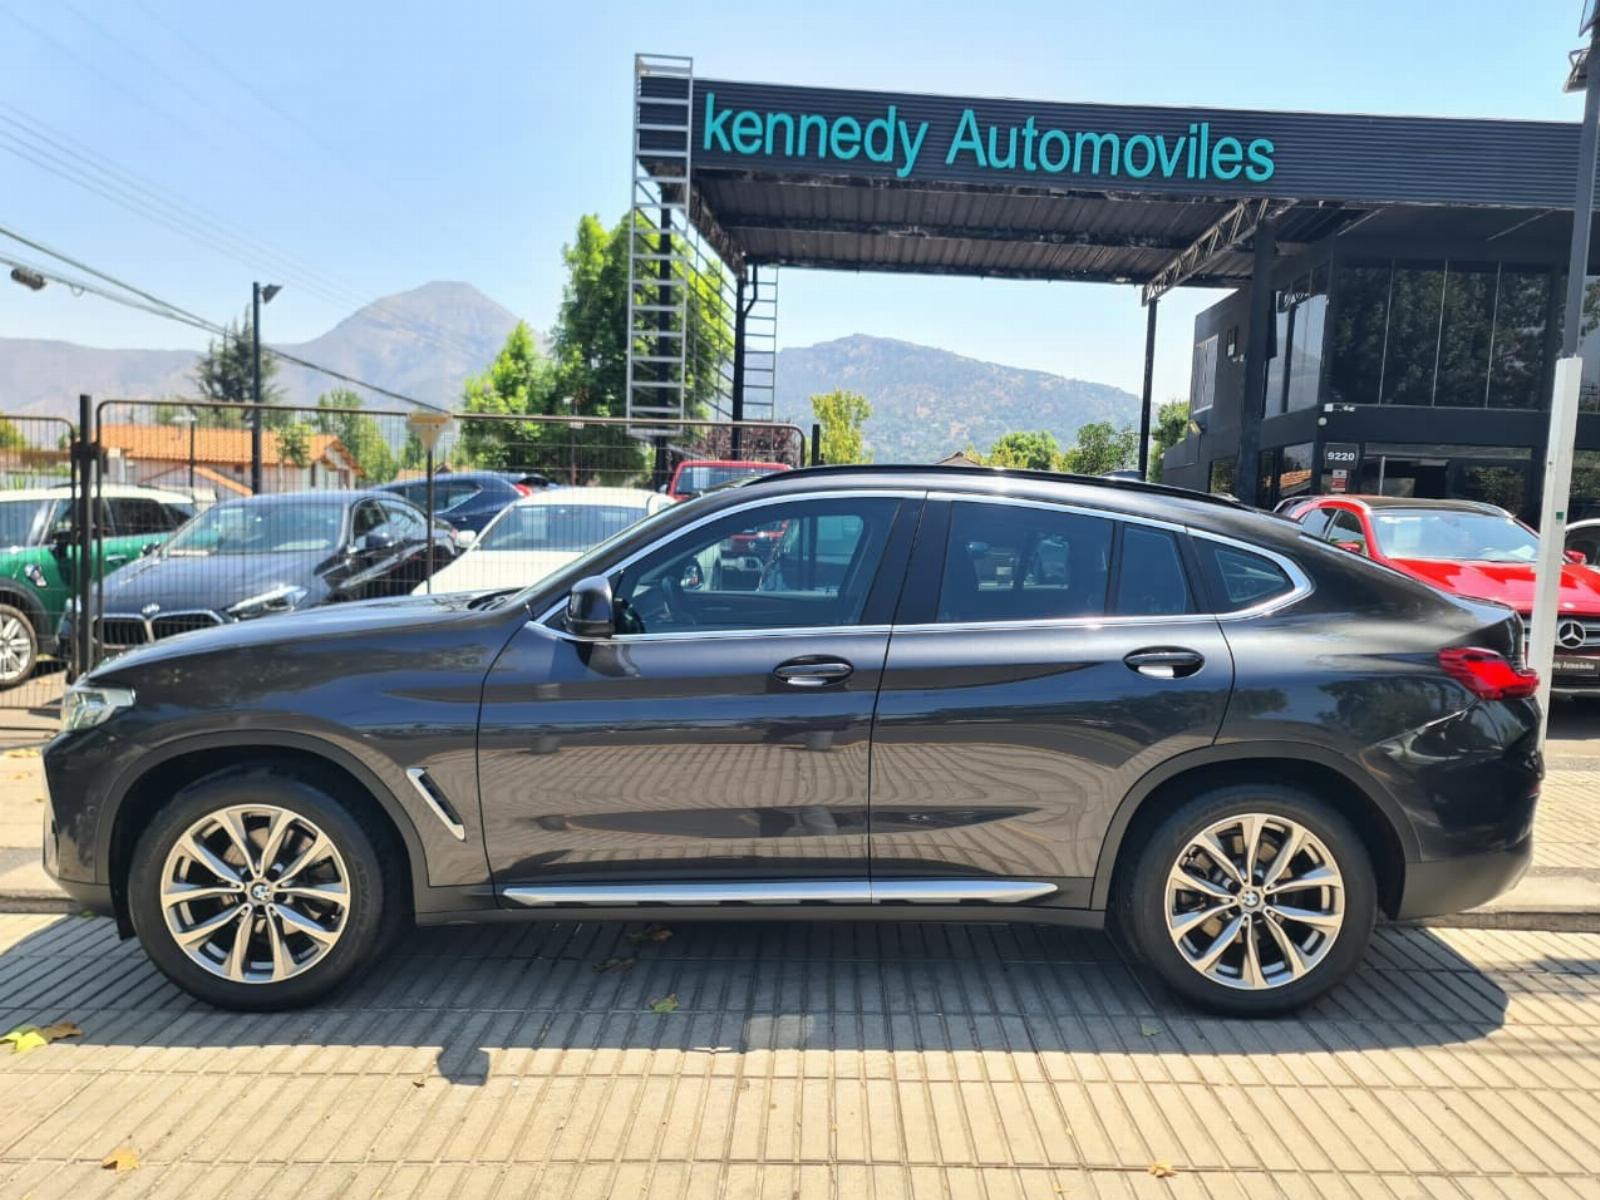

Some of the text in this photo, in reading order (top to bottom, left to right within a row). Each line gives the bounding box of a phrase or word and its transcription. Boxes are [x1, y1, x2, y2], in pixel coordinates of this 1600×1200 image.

[703, 92, 1276, 183] kennedy Automoviles
[1327, 452, 1355, 461] 9220
